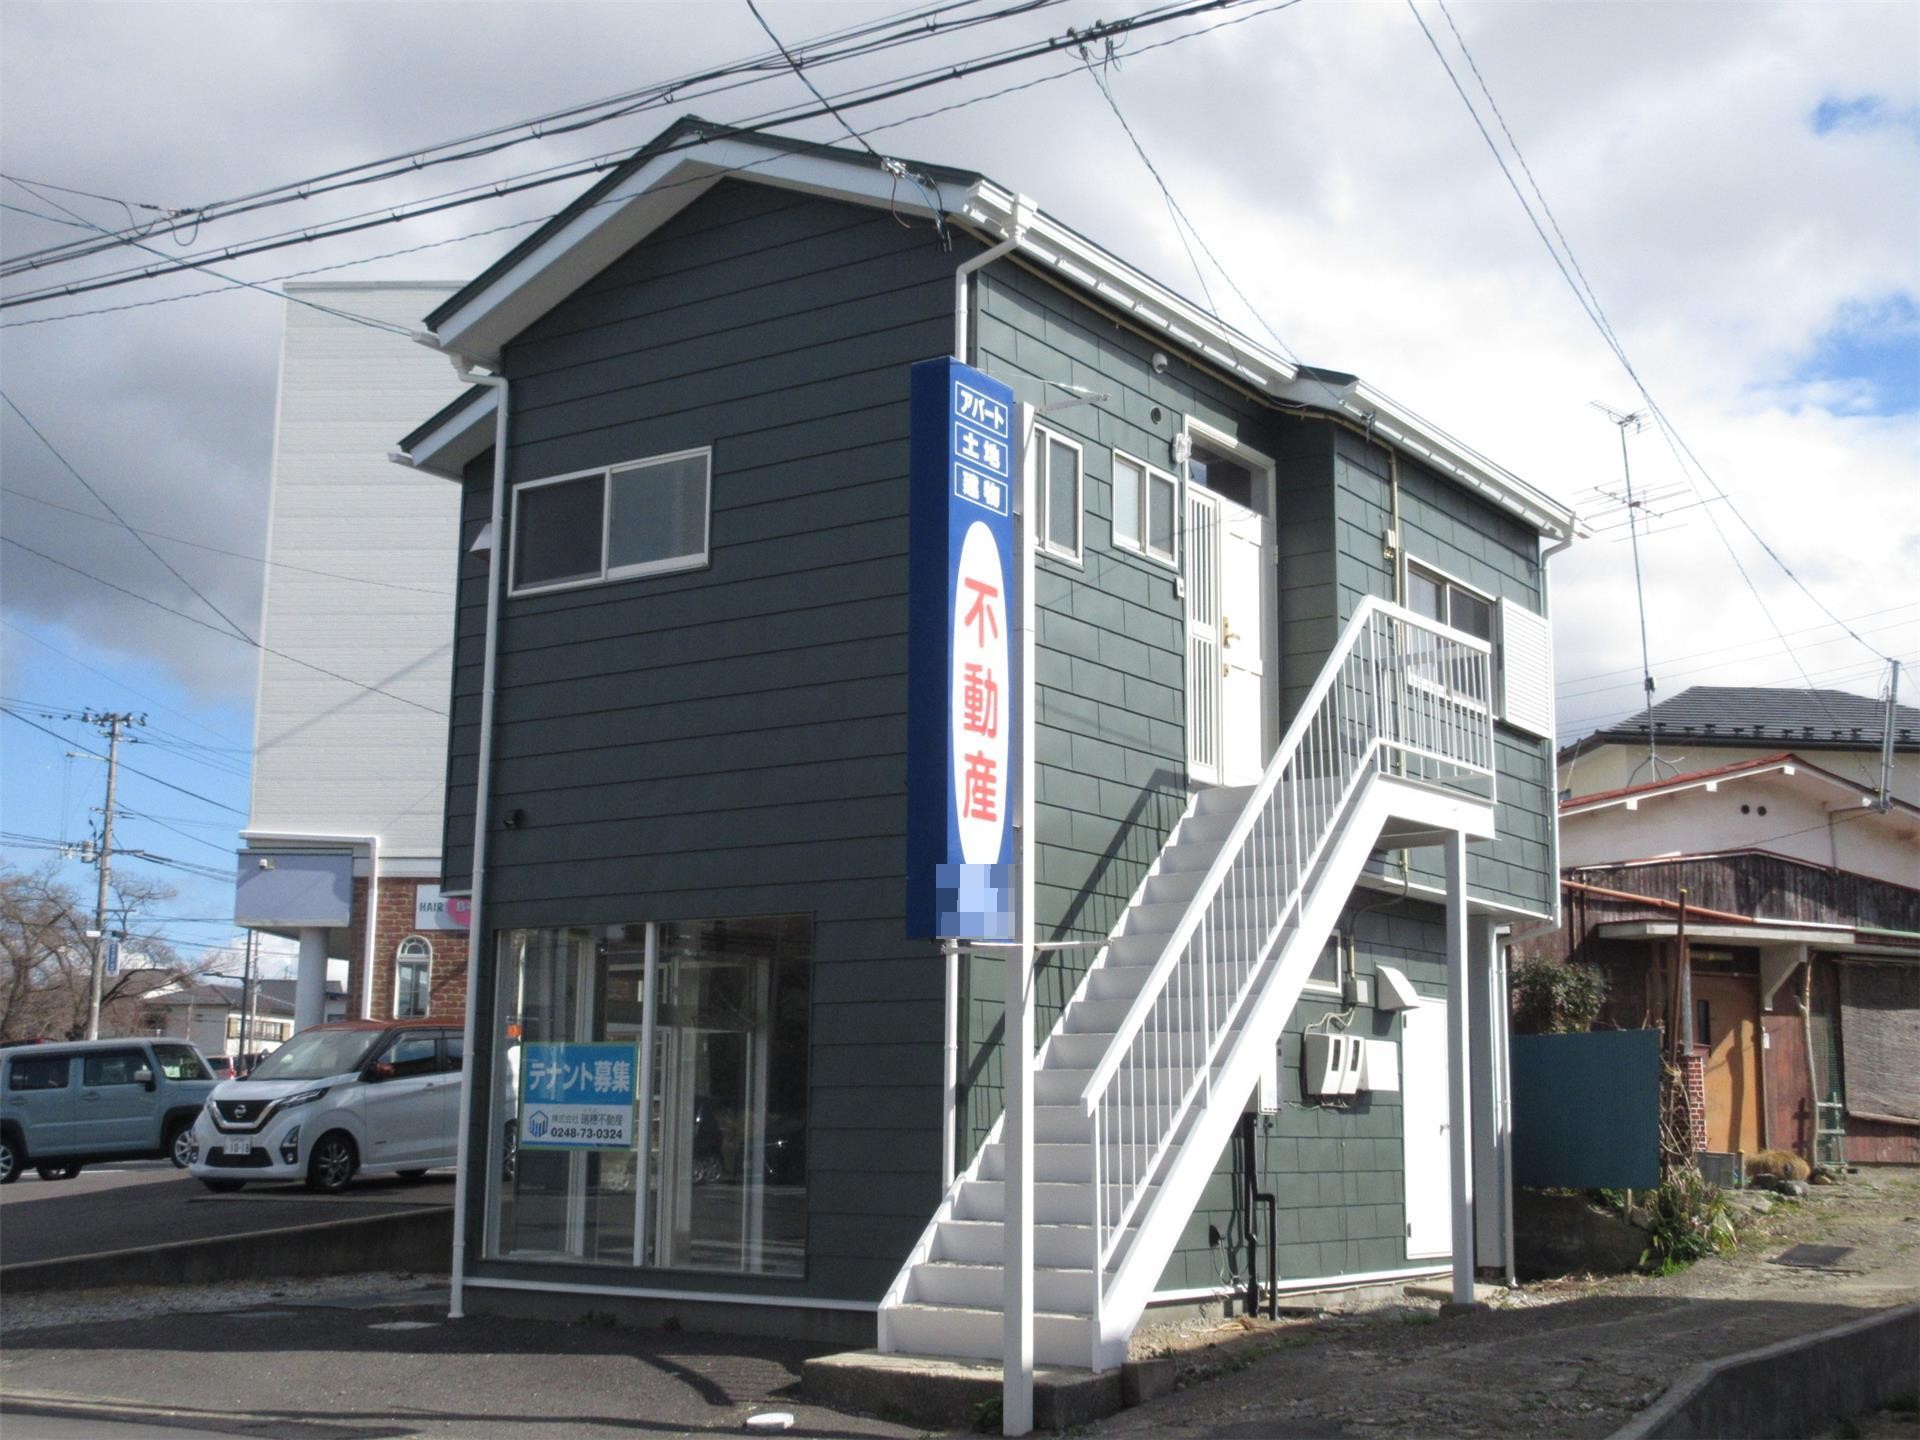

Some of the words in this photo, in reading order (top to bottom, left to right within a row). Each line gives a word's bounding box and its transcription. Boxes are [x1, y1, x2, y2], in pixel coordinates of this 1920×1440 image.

[960, 389, 1005, 429] アパート
[961, 431, 1001, 469] 土地
[963, 577, 999, 823] 不動産
[419, 901, 444, 913] HAIR
[529, 1060, 631, 1093] テナント募集
[551, 1128, 623, 1139] 0248-73-0324
